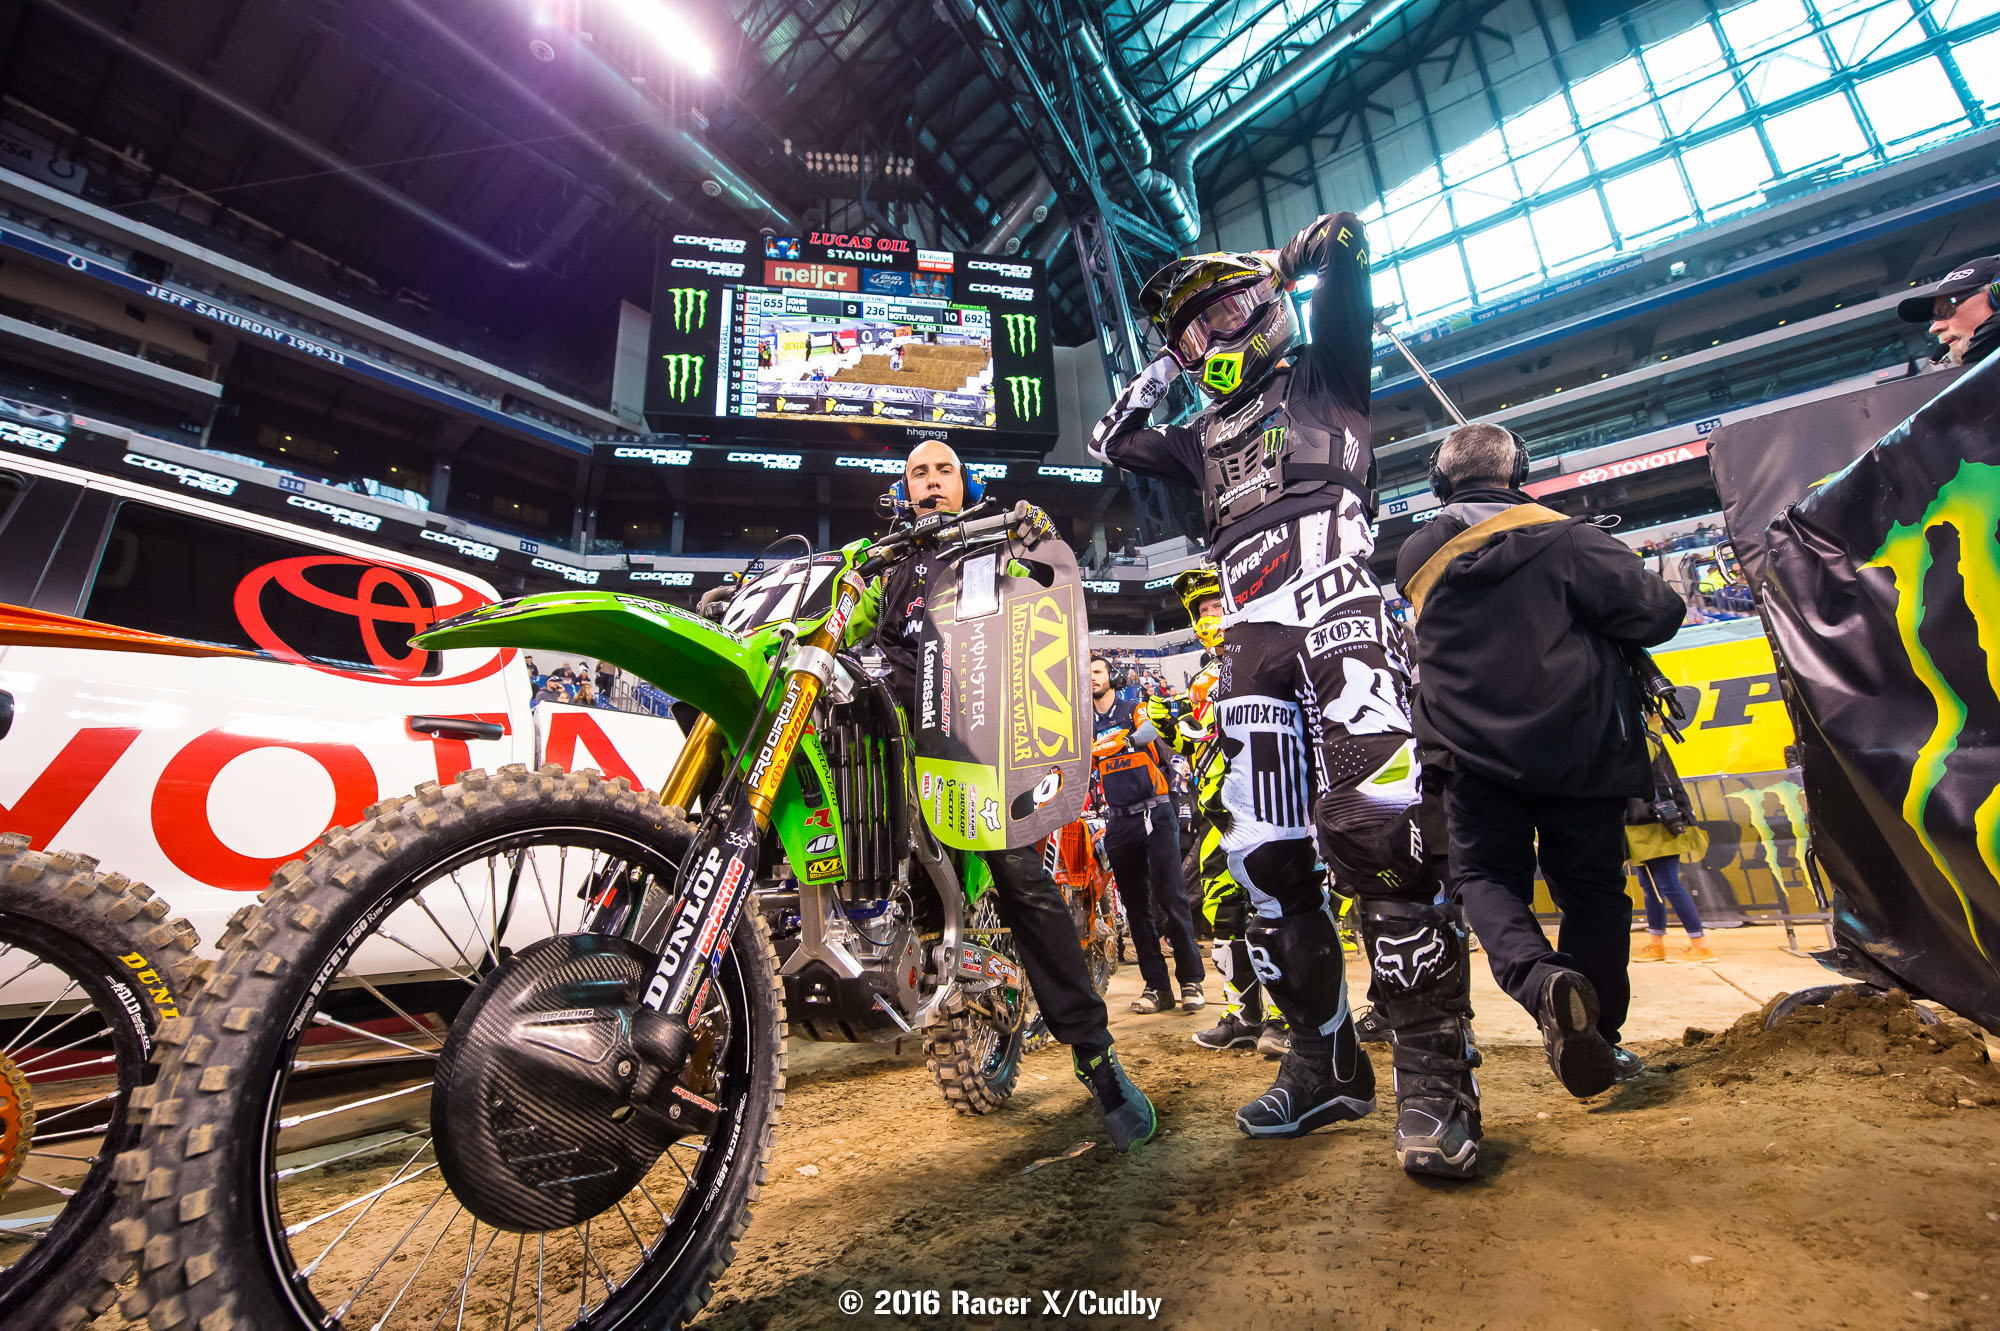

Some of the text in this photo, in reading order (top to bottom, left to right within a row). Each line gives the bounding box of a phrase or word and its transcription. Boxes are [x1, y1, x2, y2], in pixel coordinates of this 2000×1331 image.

[673, 234, 747, 248] COOPER
[708, 244, 747, 254] TIRES
[809, 232, 910, 252] LUCAS OIL
[671, 258, 746, 271] COOPER
[827, 249, 893, 264] STADIUM
[706, 267, 745, 277] TIRES
[968, 261, 1033, 274] COOPER
[1000, 271, 1033, 279] TIRES
[1597, 258, 1643, 279] LOCATION
[969, 283, 1034, 296] COOPER
[1001, 292, 1034, 301] TIRES
[763, 298, 784, 308] 655
[848, 305, 857, 314] 9
[866, 306, 885, 316] 236
[944, 312, 958, 323] 10
[964, 314, 983, 323] 692
[146, 285, 346, 365] JEFF SATURDAY 1999-11
[906, 428, 948, 439] hhgregg
[1698, 420, 1720, 433] 325
[613, 448, 693, 459] COOPER
[651, 457, 692, 466] TIRES
[727, 452, 802, 464] COOPER
[1610, 448, 1695, 475] TOYOTA
[123, 453, 239, 488] COOPER
[763, 462, 802, 470] TIRES
[835, 457, 907, 470] COOPER
[870, 465, 906, 474] TIRES
[1038, 466, 1104, 477] COOPER
[178, 474, 238, 496] TIRES
[280, 477, 304, 491] 318
[1070, 475, 1102, 483] TIRES
[1219, 469, 1271, 505] Kawasaki
[286, 495, 382, 524] COOPER
[1390, 502, 1407, 513] 324
[332, 513, 381, 531] TIRES
[420, 529, 499, 554] COOPER
[521, 541, 538, 553] 319
[458, 545, 497, 561] TIRES
[532, 558, 600, 579] COOPER
[748, 562, 764, 571] 20
[563, 572, 599, 585] TIRES
[629, 571, 695, 581] COOPER
[1293, 562, 1370, 621] FOX
[826, 591, 854, 641] SFF AIR
[1310, 619, 1373, 652] FOX
[1334, 643, 1369, 656] AETERNO
[921, 639, 938, 730] Kawasaki
[941, 631, 952, 738] PRO CIRCUIT
[960, 641, 968, 716] ENERGY
[970, 621, 988, 732] MONSTER
[1012, 602, 1033, 763] MECHANIX WEAR
[784, 691, 813, 757] SHOWA
[1272, 705, 1297, 728] FOX
[747, 744, 774, 790] PRO
[765, 680, 801, 750] CIRCUIT
[812, 738, 839, 807] SPECIALIZED
[1105, 758, 1132, 772] KTM
[1409, 819, 1423, 864] FOX
[726, 868, 755, 935] PISTONS
[642, 846, 723, 1012] DUNLOP
[309, 904, 384, 996] EXCEL A60 Rim
[541, 1009, 594, 1022] BRAKING
[672, 1085, 692, 1099] PRO
[724, 1123, 741, 1163] EXCEL
[716, 1163, 729, 1188] A60
